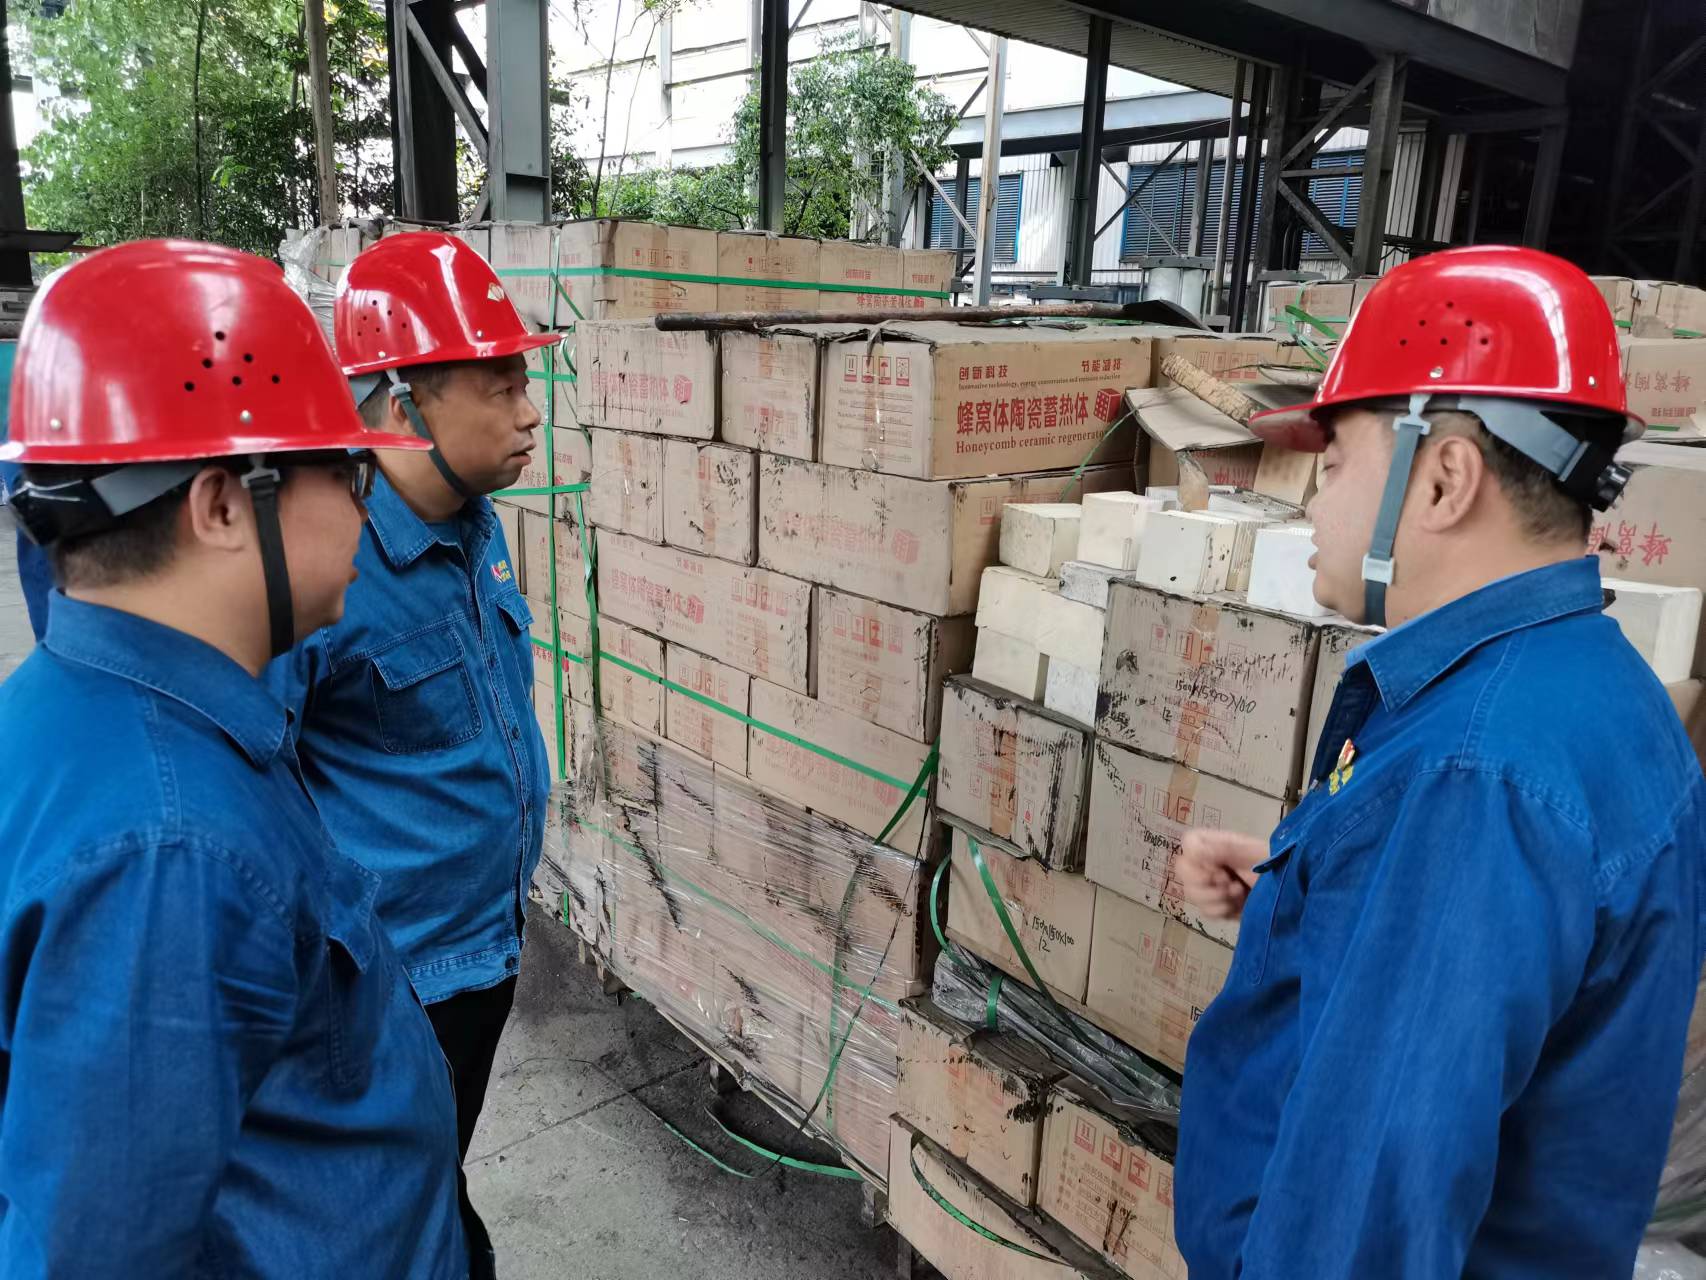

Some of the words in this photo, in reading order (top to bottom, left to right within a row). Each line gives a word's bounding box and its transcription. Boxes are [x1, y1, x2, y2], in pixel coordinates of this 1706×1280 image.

[957, 392, 1089, 436] 蜂窝体陶瓷蓄热体
[956, 438, 1017, 455] Honeycomb
[1019, 432, 1056, 448] ceramic
[1058, 429, 1106, 446] regenerato
[1038, 935, 1051, 953] 12
